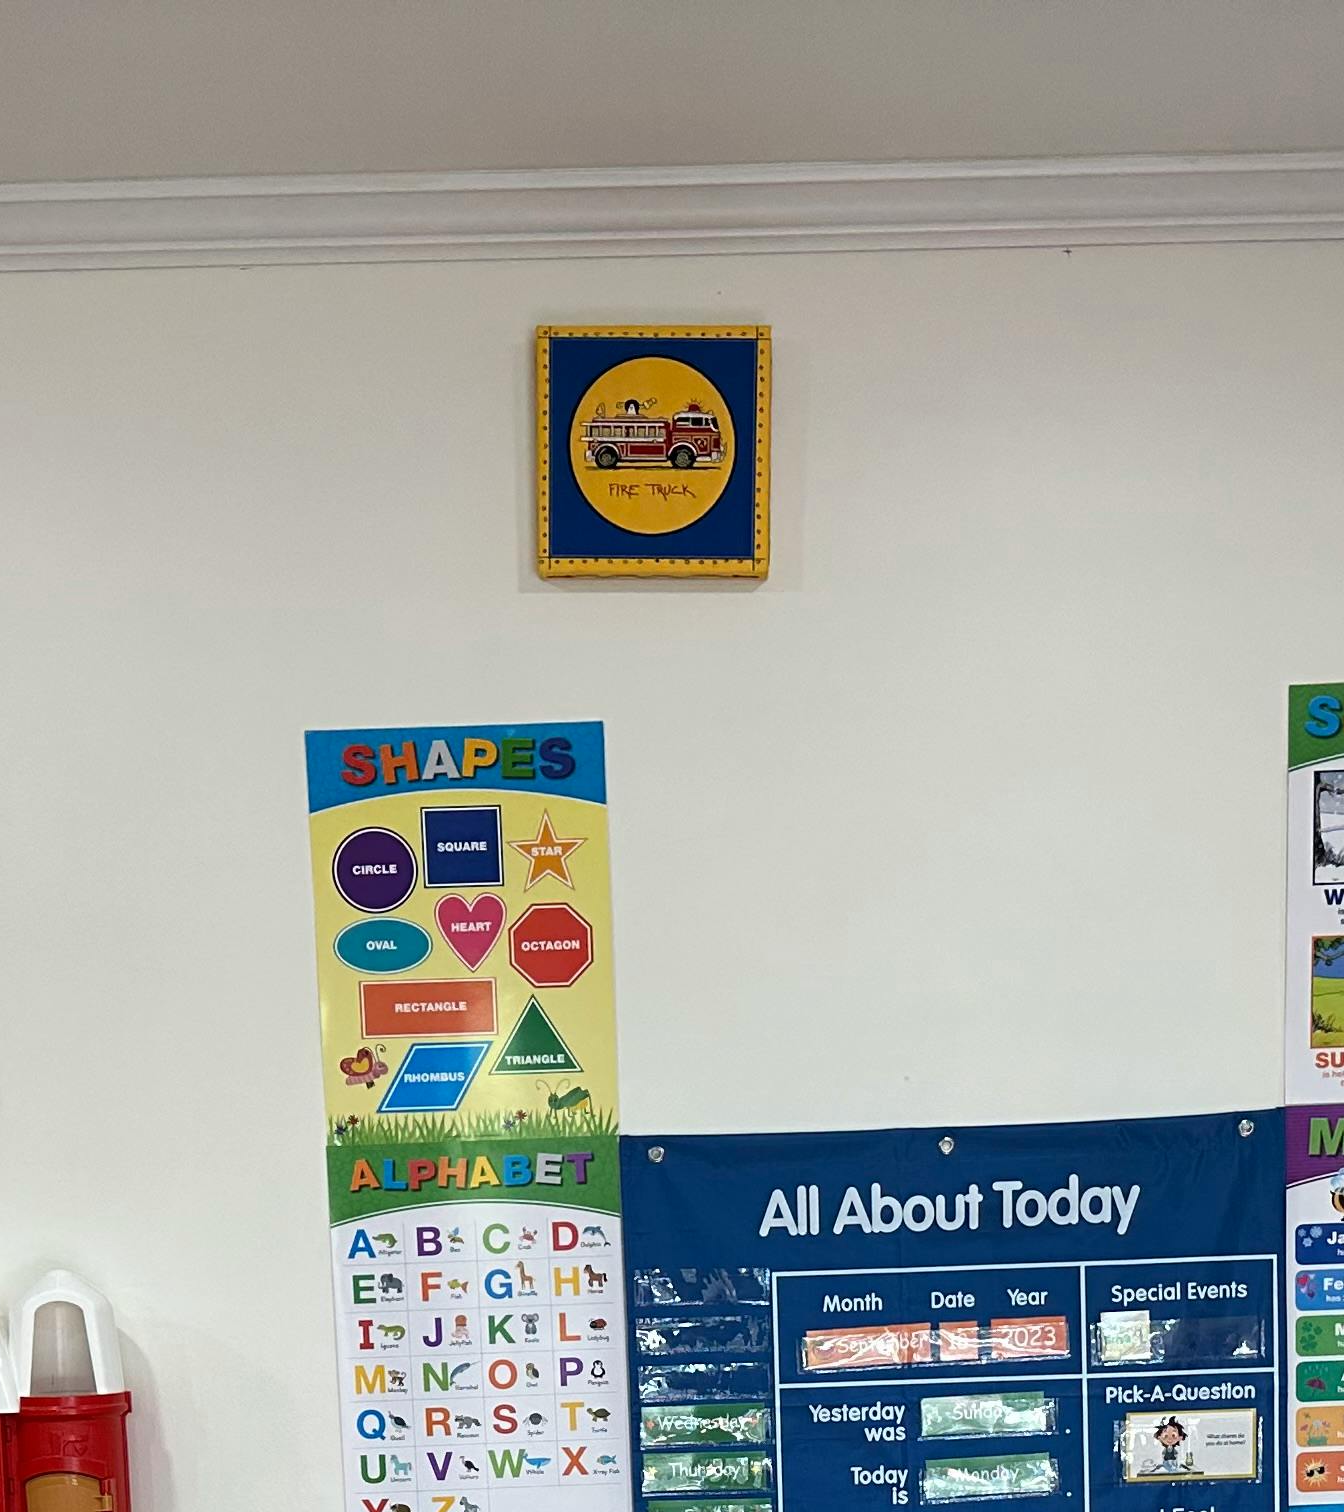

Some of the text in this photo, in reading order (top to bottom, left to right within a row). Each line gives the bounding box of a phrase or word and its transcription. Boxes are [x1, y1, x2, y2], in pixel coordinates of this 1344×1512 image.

[609, 483, 696, 501] FIRE TRUCK
[341, 736, 576, 786] SHAPES
[437, 841, 563, 857] SQUARE STAR
[352, 863, 398, 876] CIRCLE
[451, 921, 492, 933] HEART
[366, 940, 398, 951] OVAL
[521, 939, 580, 952] OCTAGON
[395, 1001, 467, 1013] RECTANGLE
[504, 1054, 566, 1066] TRIANGLE
[403, 1071, 465, 1083] RHOMBUS
[350, 1151, 594, 1193] ALPHABET
[759, 1173, 1140, 1237] All About Today
[348, 1229, 376, 1260] A
[416, 1226, 443, 1257] B
[482, 1223, 511, 1254] C
[551, 1221, 579, 1251] D
[352, 1274, 377, 1305] E
[420, 1271, 443, 1302] F
[1111, 1281, 1248, 1306] Special Events
[823, 1288, 1048, 1313] Month Date Year
[1002, 1327, 1056, 1347] 2023
[1105, 1383, 1256, 1404] Pick-A-Question
[809, 1401, 905, 1425] Yesterday
[864, 1426, 906, 1442] was
